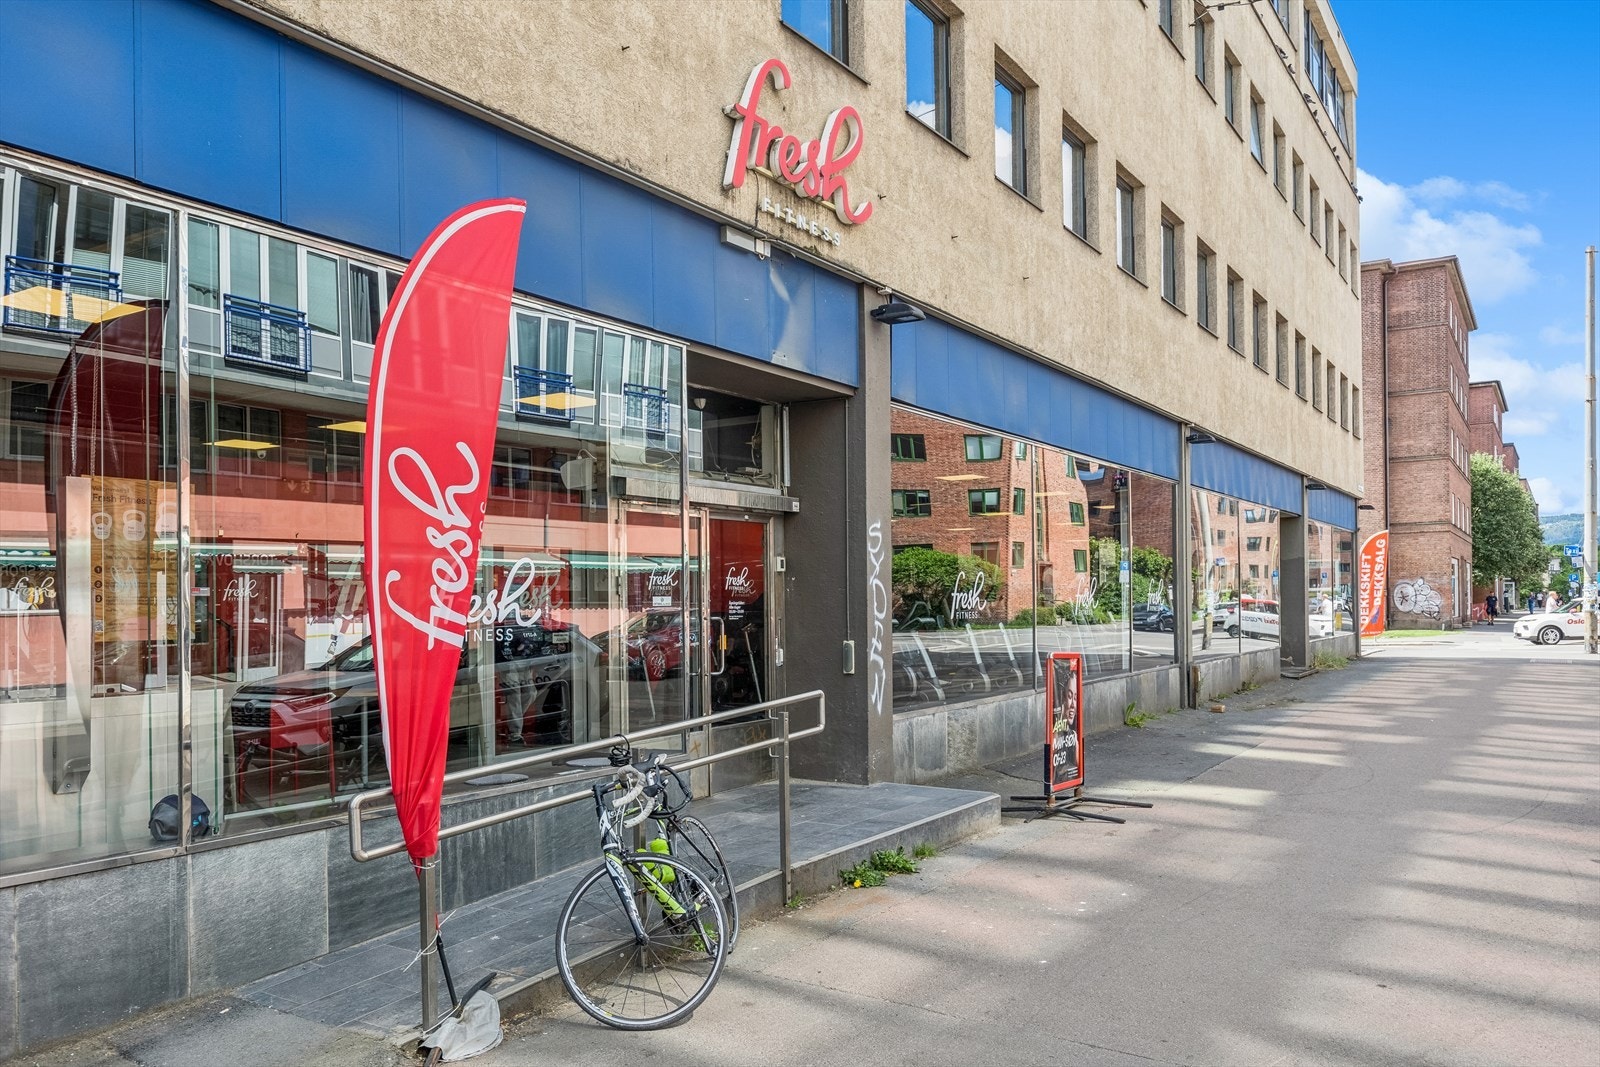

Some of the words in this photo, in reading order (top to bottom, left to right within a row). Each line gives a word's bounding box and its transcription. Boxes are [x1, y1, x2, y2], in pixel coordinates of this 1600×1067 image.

[723, 58, 872, 224] fresh
[762, 197, 841, 246] FITNESS
[385, 441, 480, 650] fresh
[223, 579, 259, 601] fresh
[467, 557, 541, 627] esh
[648, 564, 678, 590] fresh
[725, 567, 750, 590] fresh
[951, 571, 987, 619] fresh
[1360, 553, 1371, 625] DEKKSKIFT
[1374, 538, 1386, 606] DEKKSALG
[464, 628, 514, 641] TNESS
[956, 611, 978, 619] FITNESS
